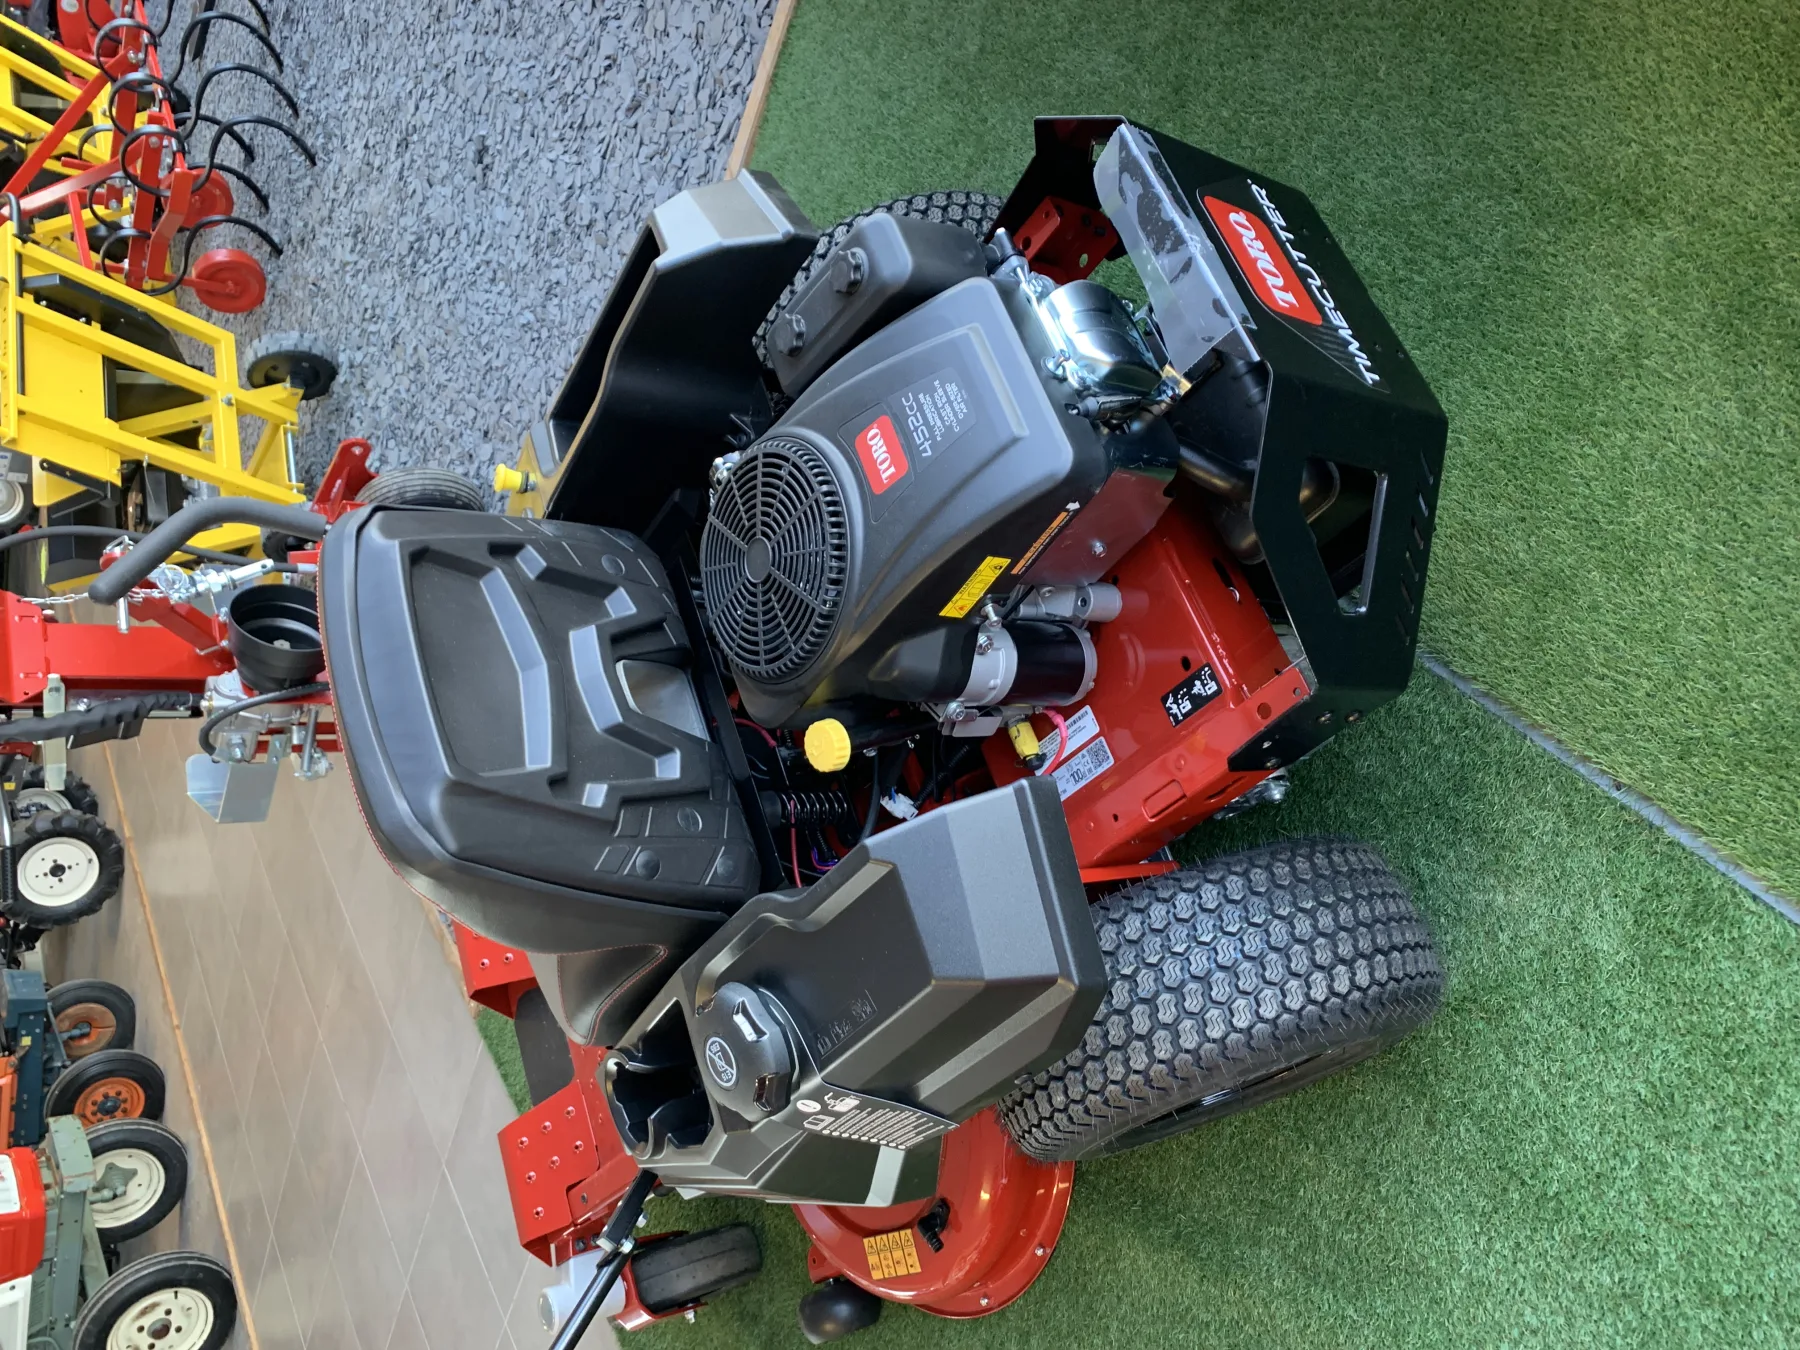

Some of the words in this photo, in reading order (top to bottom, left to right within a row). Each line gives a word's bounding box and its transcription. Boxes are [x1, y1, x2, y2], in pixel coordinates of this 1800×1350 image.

[1228, 211, 1299, 308] TORO
[1250, 183, 1380, 385] TIMECUTTER
[933, 379, 947, 403] SLEEVE
[933, 392, 943, 408] IRON
[945, 382, 964, 419] OVER-SIZED
[951, 382, 962, 403] FILTER
[918, 392, 935, 426] PRESSURE
[925, 393, 945, 433] LUBRICATION
[940, 408, 950, 426] CAST
[945, 403, 960, 432] CYLINDER
[960, 401, 968, 413] AIR
[902, 392, 932, 457] 452CC
[933, 425, 942, 441] FULL
[867, 427, 896, 484] TORO
[1028, 526, 1054, 554] CAUTION
[960, 568, 982, 595] WARNING
[1069, 768, 1084, 785] 100
